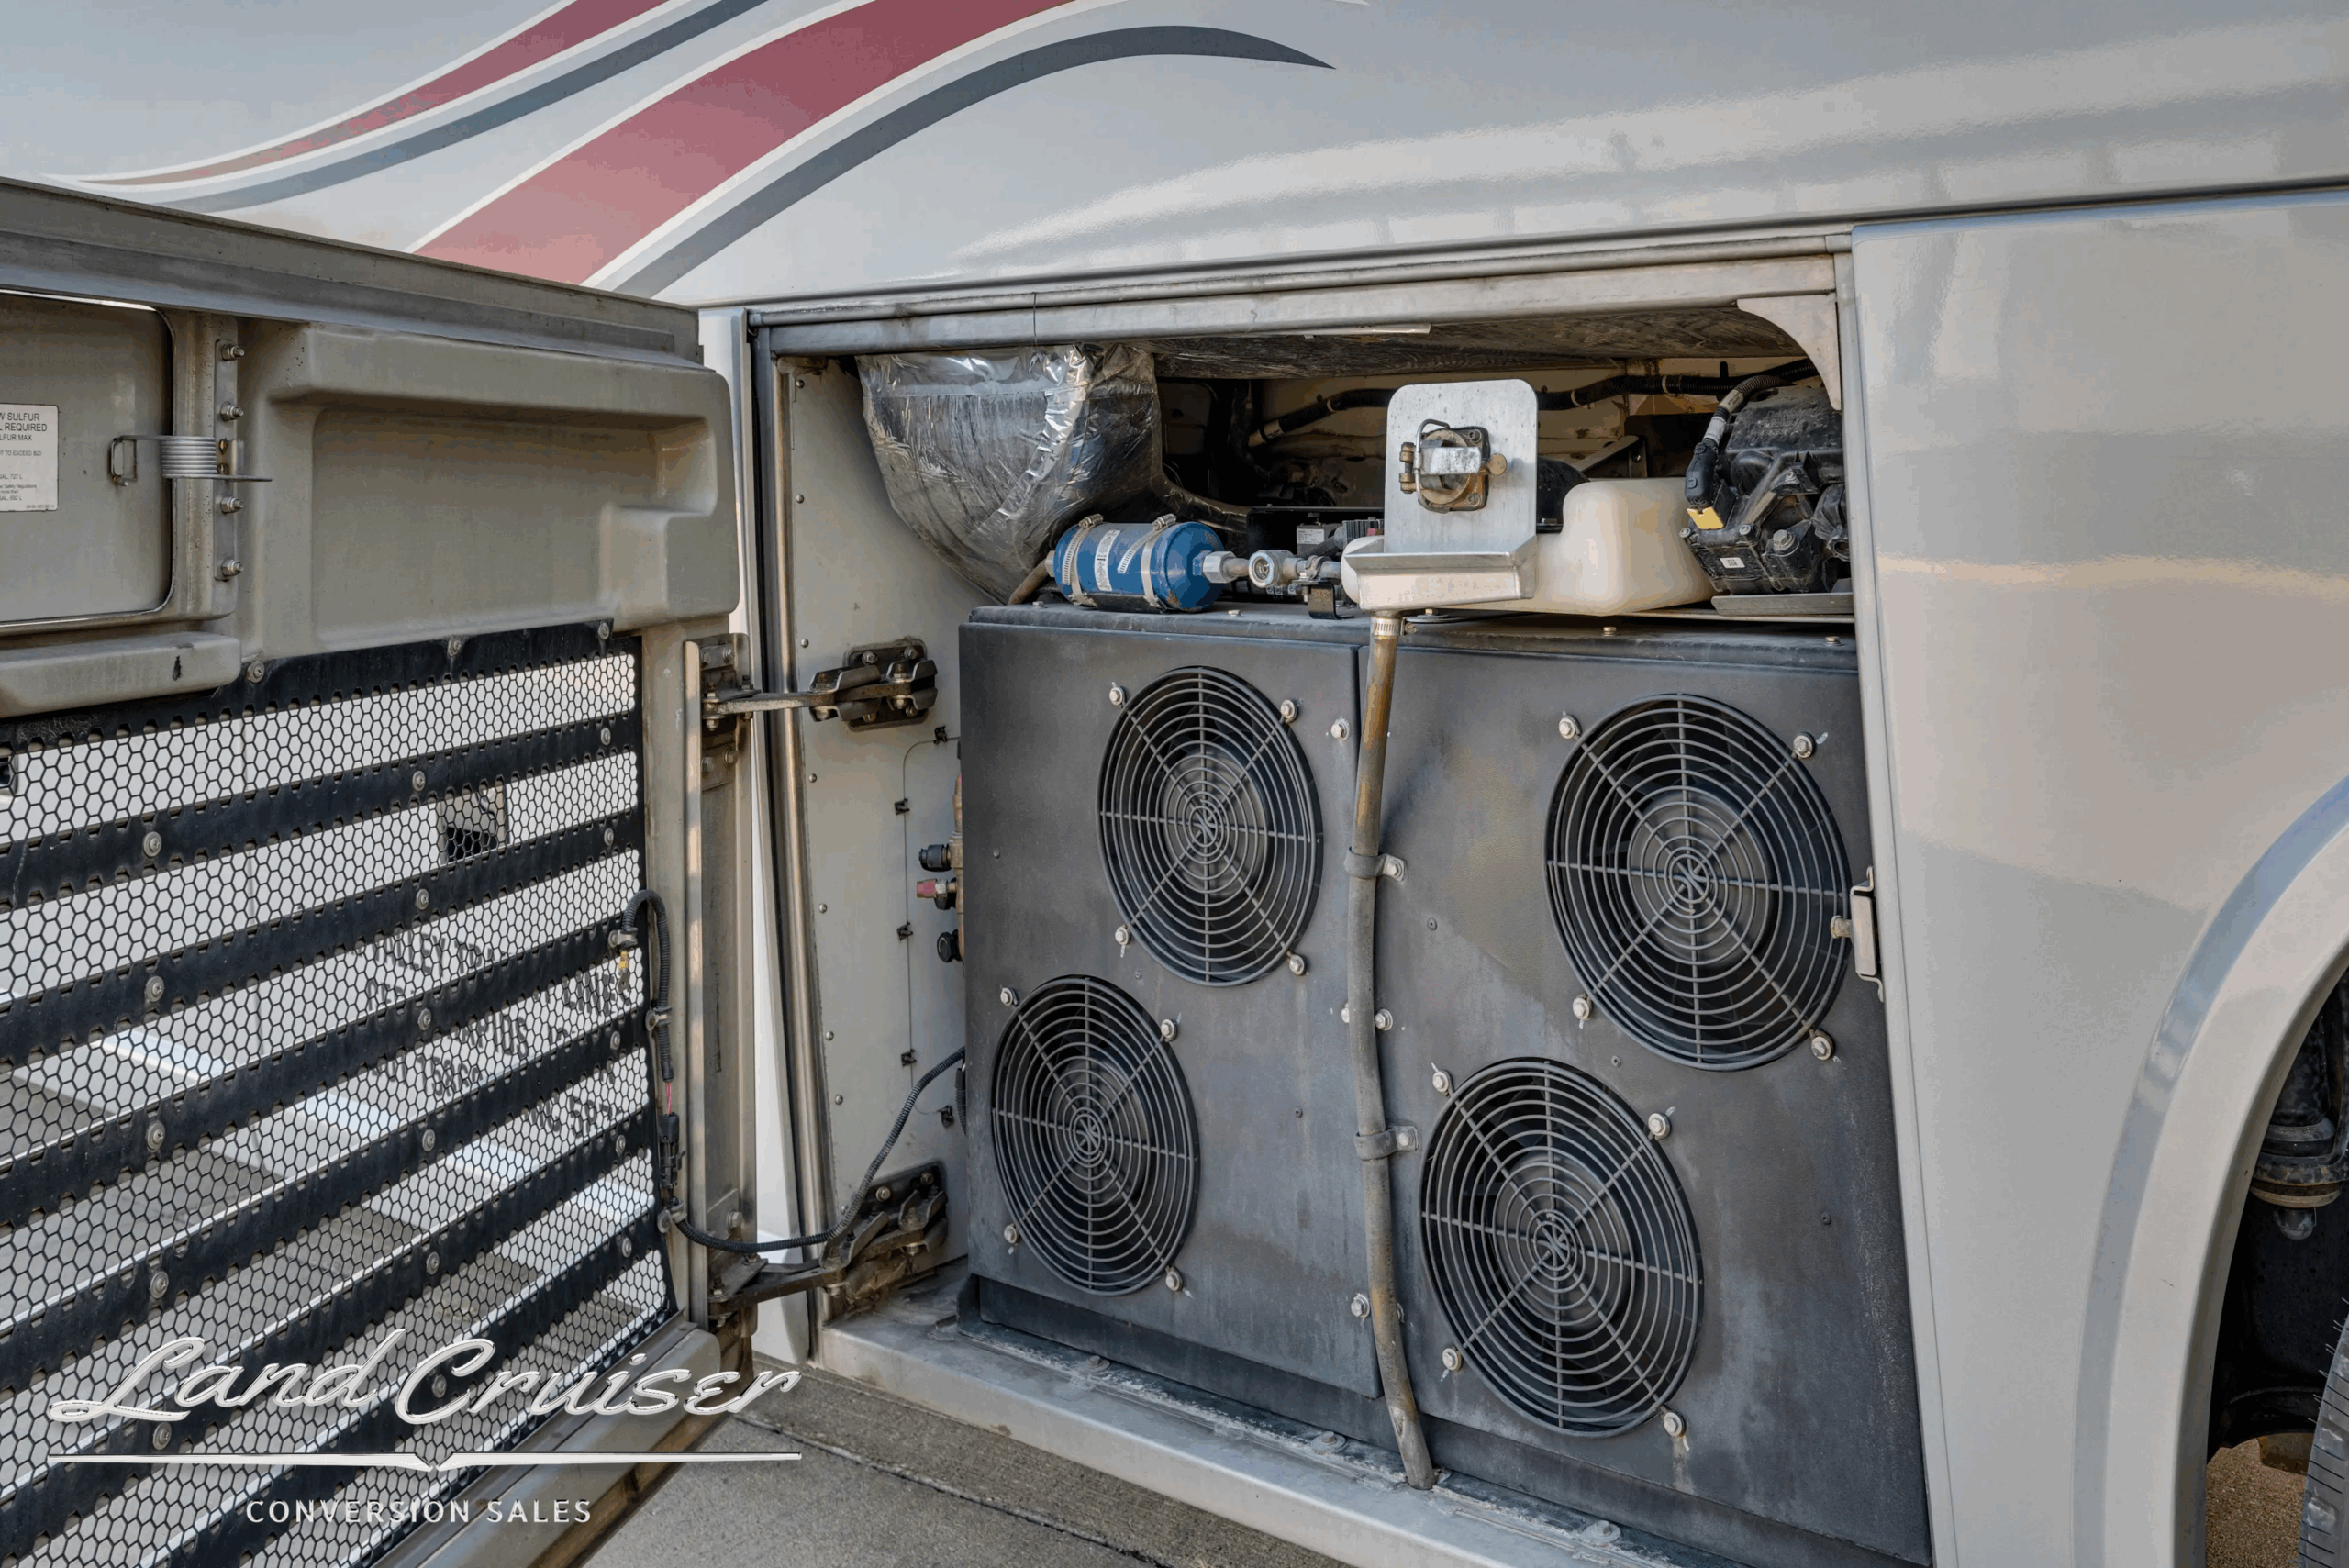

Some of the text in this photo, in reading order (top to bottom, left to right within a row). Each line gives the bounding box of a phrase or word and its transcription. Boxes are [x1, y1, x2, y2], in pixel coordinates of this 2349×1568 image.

[7, 412, 40, 421] SULFUR
[5, 422, 48, 432] REQUIRED
[451, 1012, 529, 1061] PIDS
